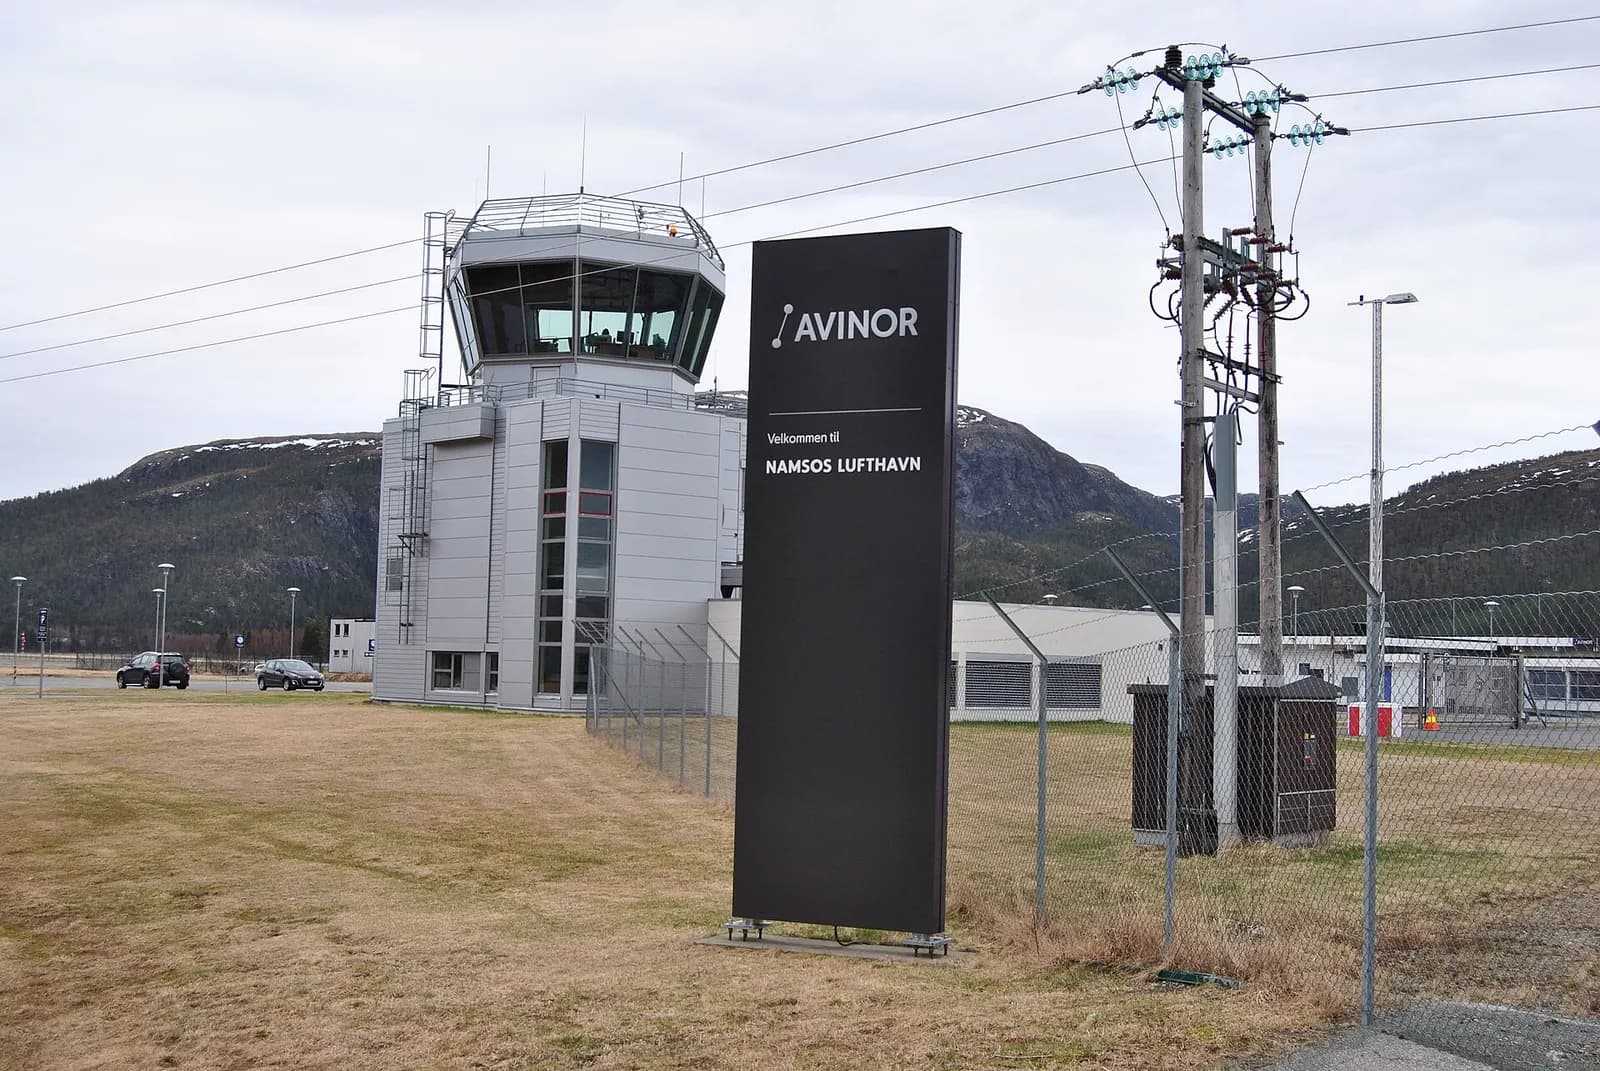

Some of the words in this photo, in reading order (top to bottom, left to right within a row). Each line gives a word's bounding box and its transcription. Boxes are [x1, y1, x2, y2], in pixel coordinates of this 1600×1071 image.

[794, 307, 919, 342] AVINOR
[767, 432, 828, 444] Velkommen
[829, 431, 840, 443] til
[766, 458, 832, 474] NAMSOS
[837, 456, 921, 473] LUFTHAVN
